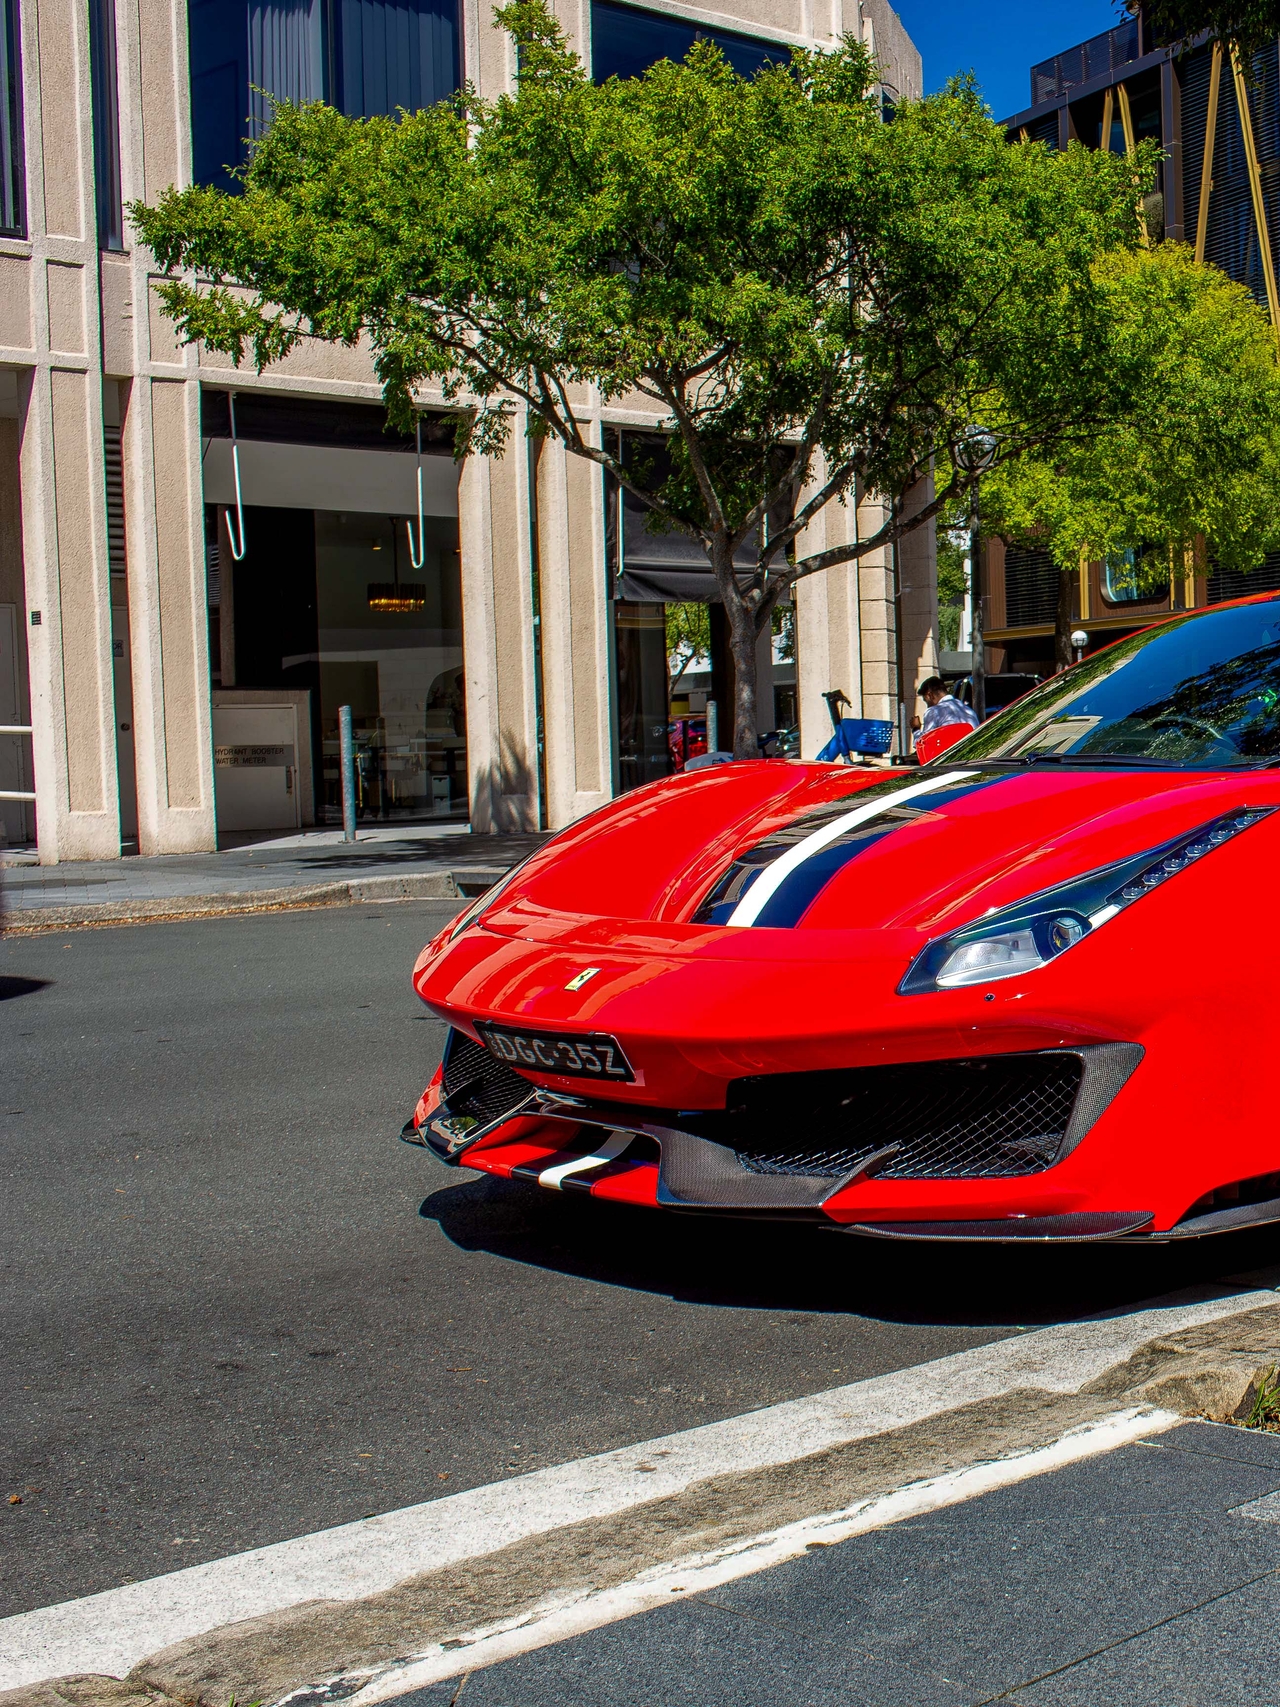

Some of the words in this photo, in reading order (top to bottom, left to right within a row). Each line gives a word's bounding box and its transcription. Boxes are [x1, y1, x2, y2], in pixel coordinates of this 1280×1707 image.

[215, 748, 248, 756] HYDRANT
[216, 757, 239, 765] WATER
[242, 756, 267, 764] METER
